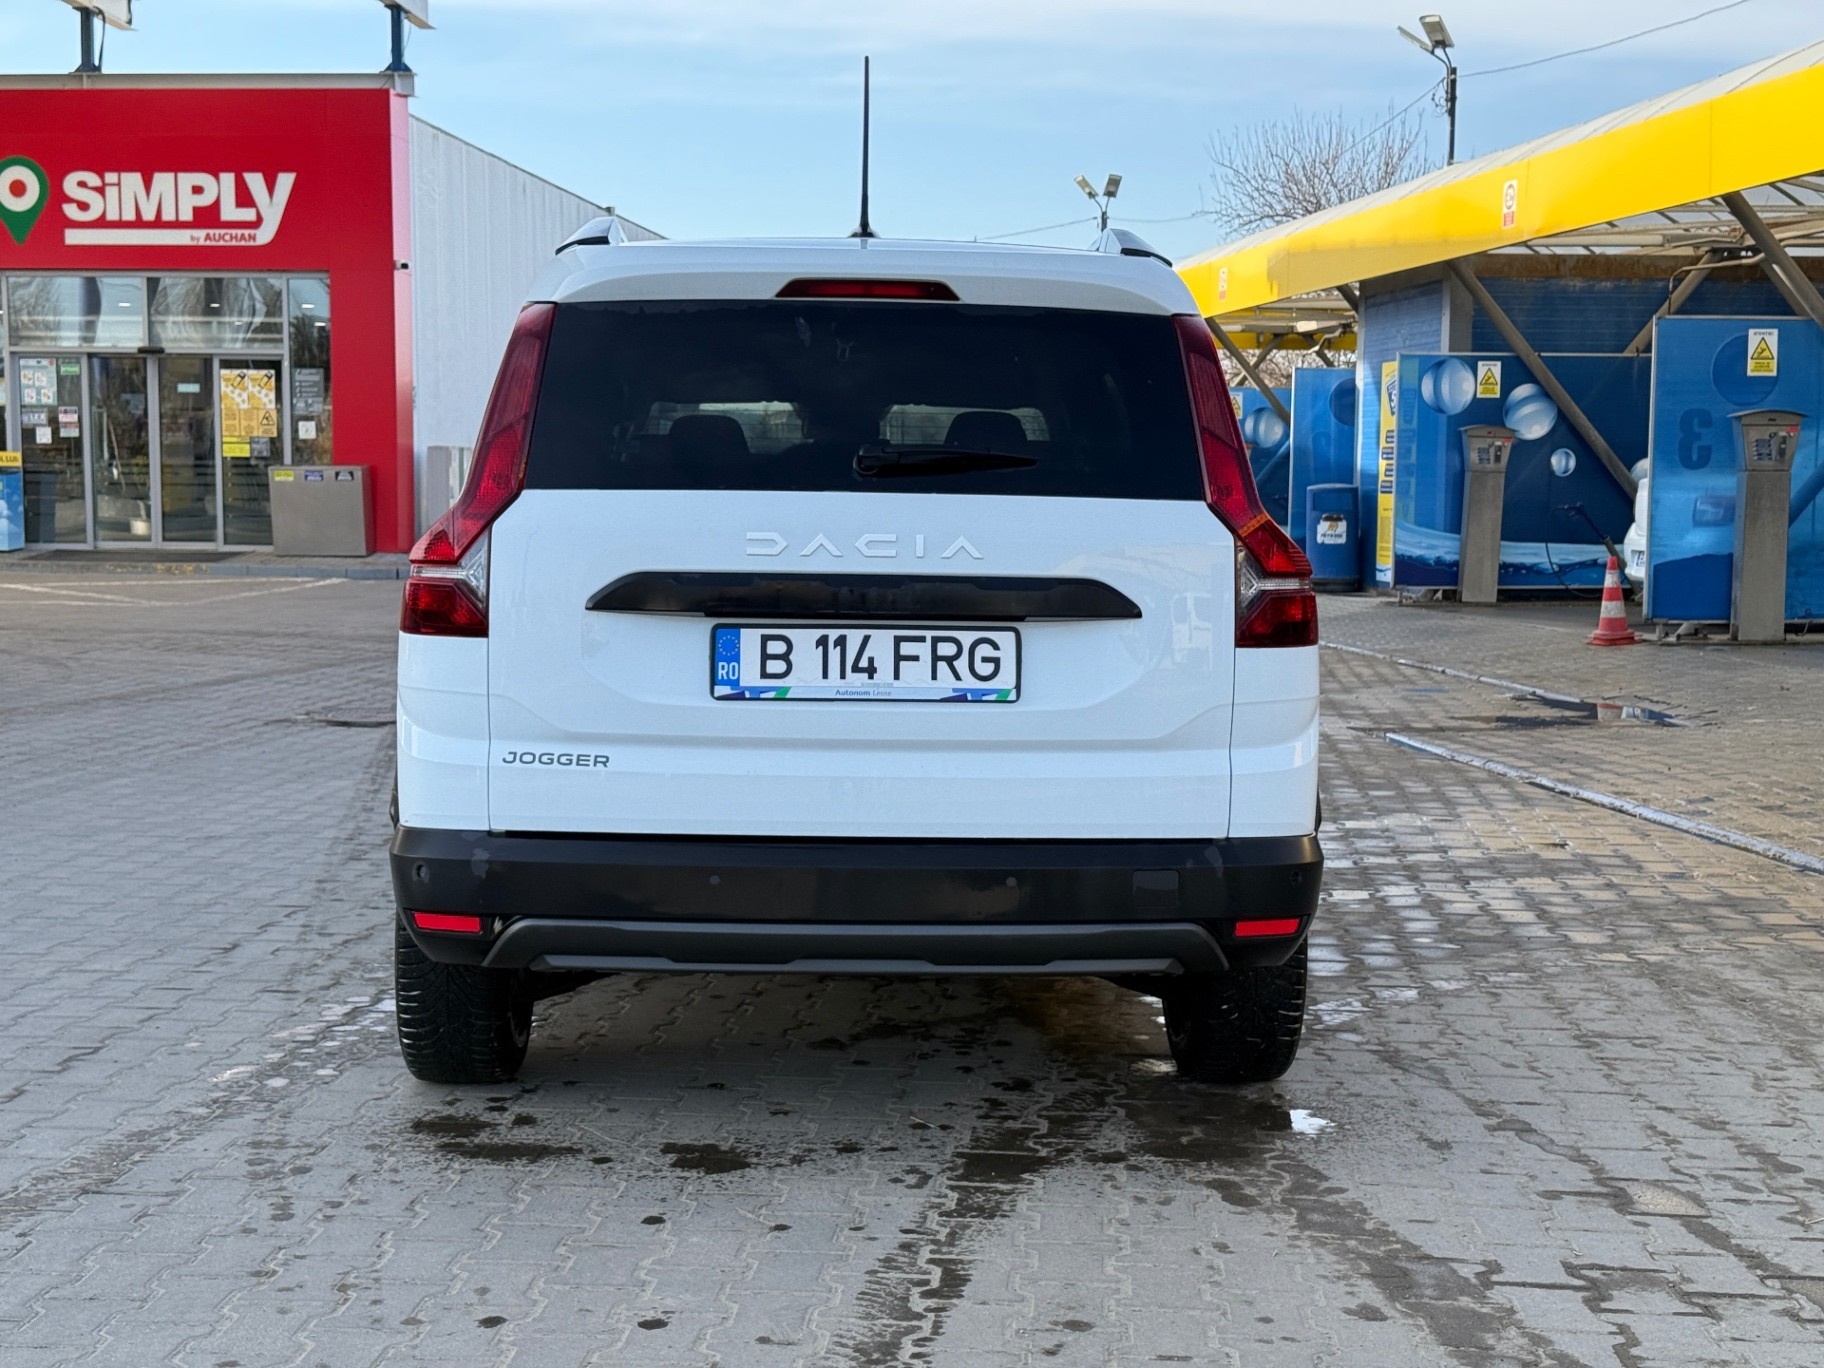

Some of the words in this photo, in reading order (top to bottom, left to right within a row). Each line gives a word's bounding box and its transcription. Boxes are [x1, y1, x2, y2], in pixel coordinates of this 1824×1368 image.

[204, 232, 257, 243] AUCHAN
[745, 532, 984, 560] DACIA
[760, 633, 794, 680] B
[815, 634, 878, 680] 114
[893, 635, 1002, 682] FRG
[718, 661, 739, 680] RO
[835, 689, 871, 697] Autonom
[502, 751, 610, 768] JOGGER
